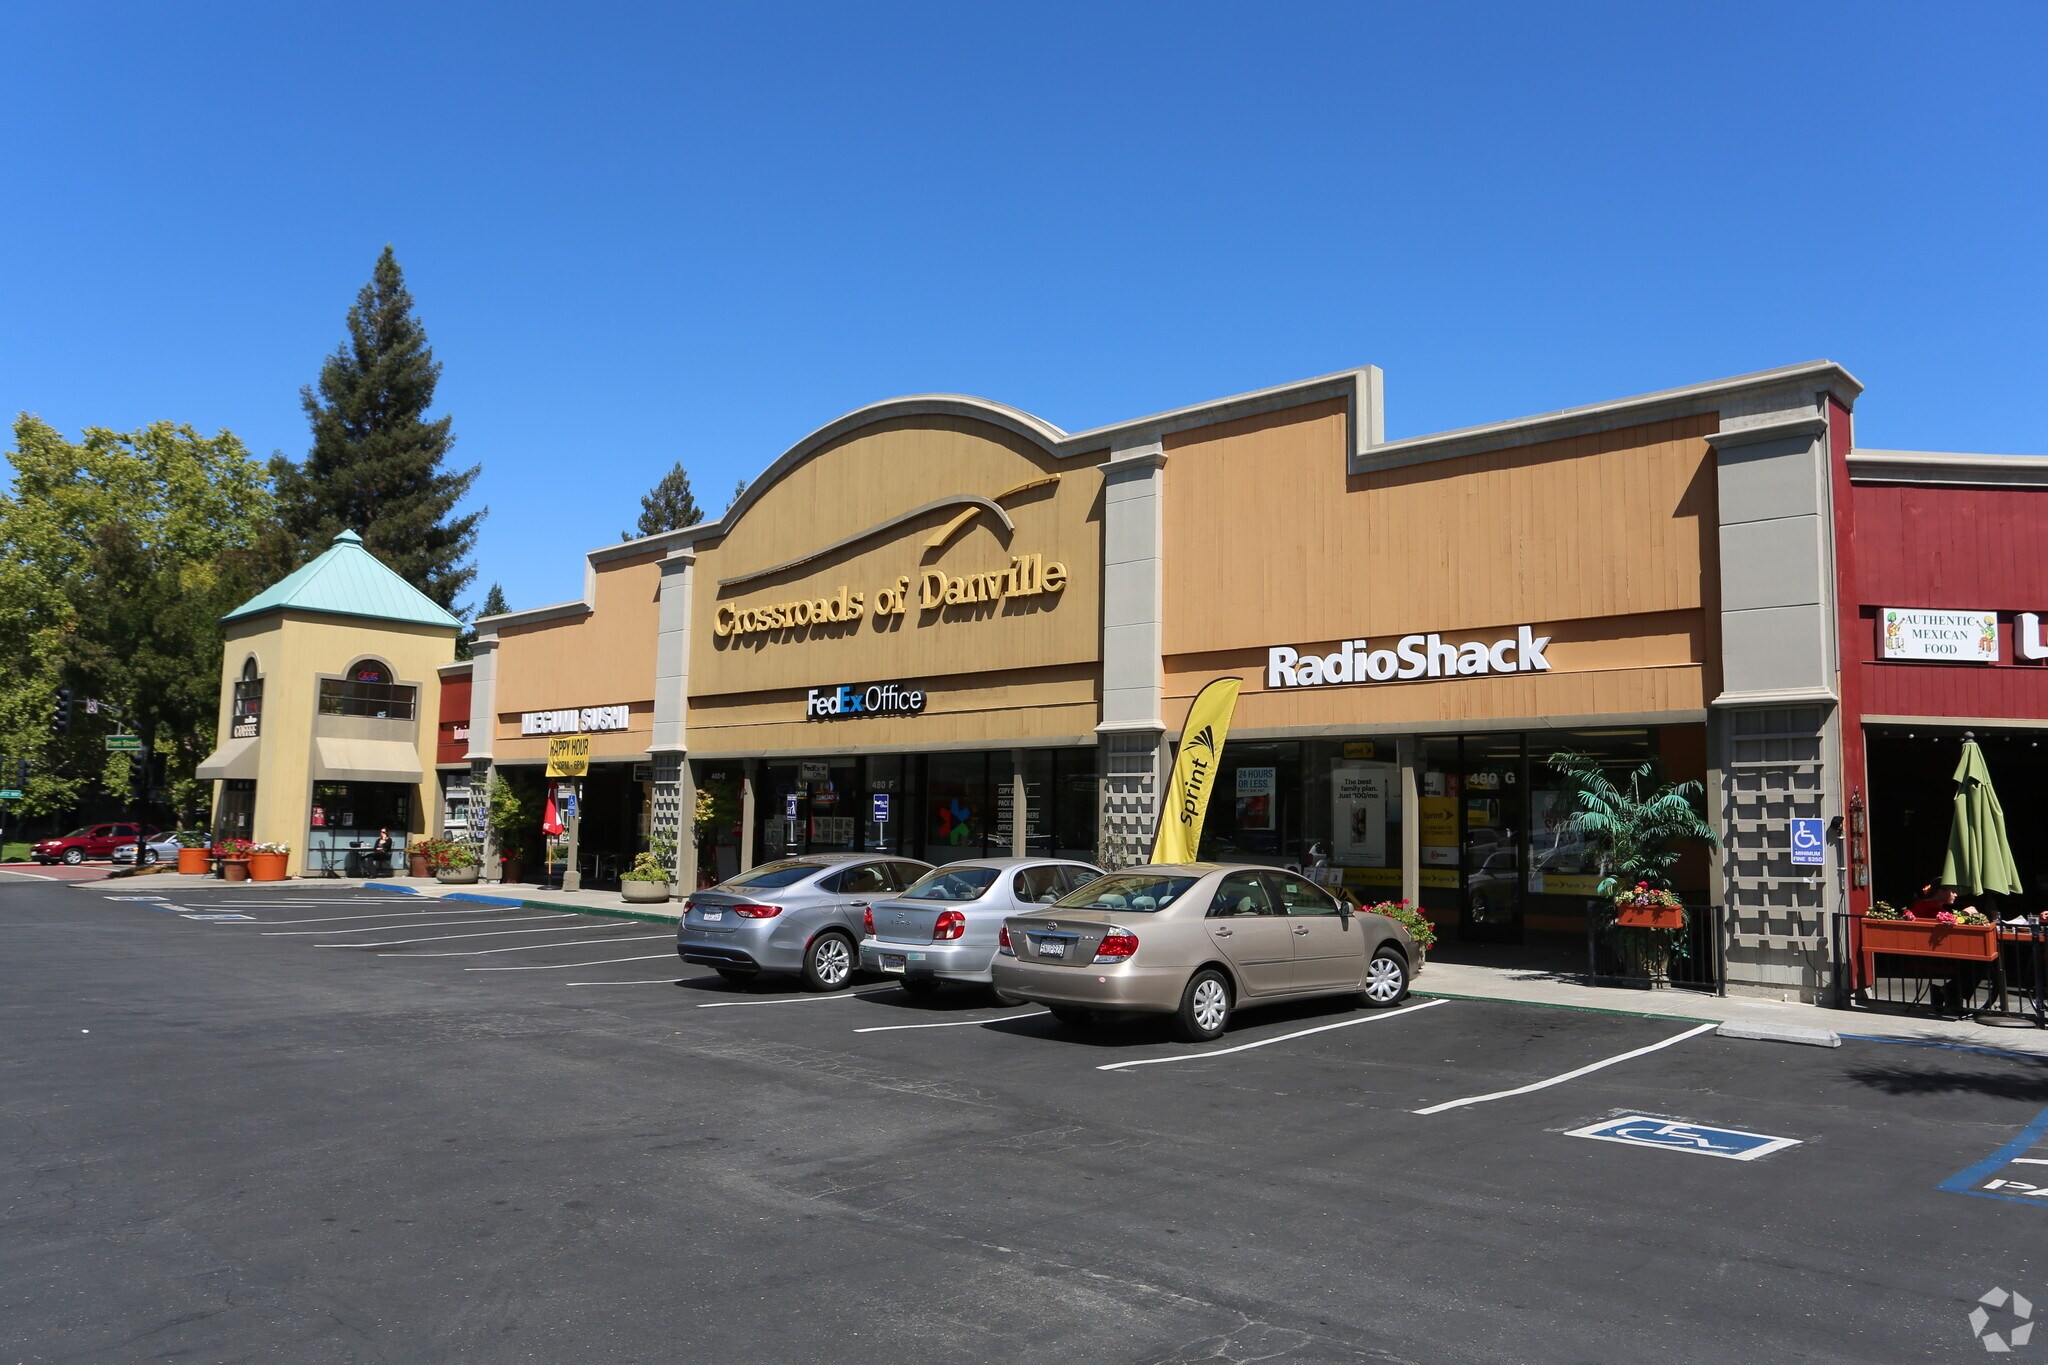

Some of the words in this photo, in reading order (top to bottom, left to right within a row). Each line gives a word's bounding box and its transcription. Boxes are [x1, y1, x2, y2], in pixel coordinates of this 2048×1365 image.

[714, 586, 865, 637] Crossroads
[874, 576, 910, 615] of
[920, 553, 1067, 610] Danville
[1905, 615, 1975, 626] AUTHENTIC
[1912, 629, 1968, 640] MEXICAN
[1925, 644, 1957, 654] FOOD
[1268, 625, 1552, 688] RadioShack
[807, 685, 863, 716] FedEx
[865, 684, 922, 711] Office
[522, 709, 579, 735] MEGUMI
[581, 705, 630, 732] SUSHI
[234, 724, 257, 737] COFFEE
[549, 740, 570, 756] HAPPY
[572, 738, 589, 755] HOUR
[1238, 770, 1246, 778] 24
[1248, 769, 1273, 778] HOURS
[1469, 772, 1497, 784] 480
[1504, 772, 1516, 784] G
[871, 781, 886, 789] 480
[888, 781, 894, 789] F
[1238, 779, 1248, 788] OR
[1249, 779, 1269, 788] LESS.
[1180, 757, 1208, 827] Sprint
[1423, 811, 1443, 820] Sprint
